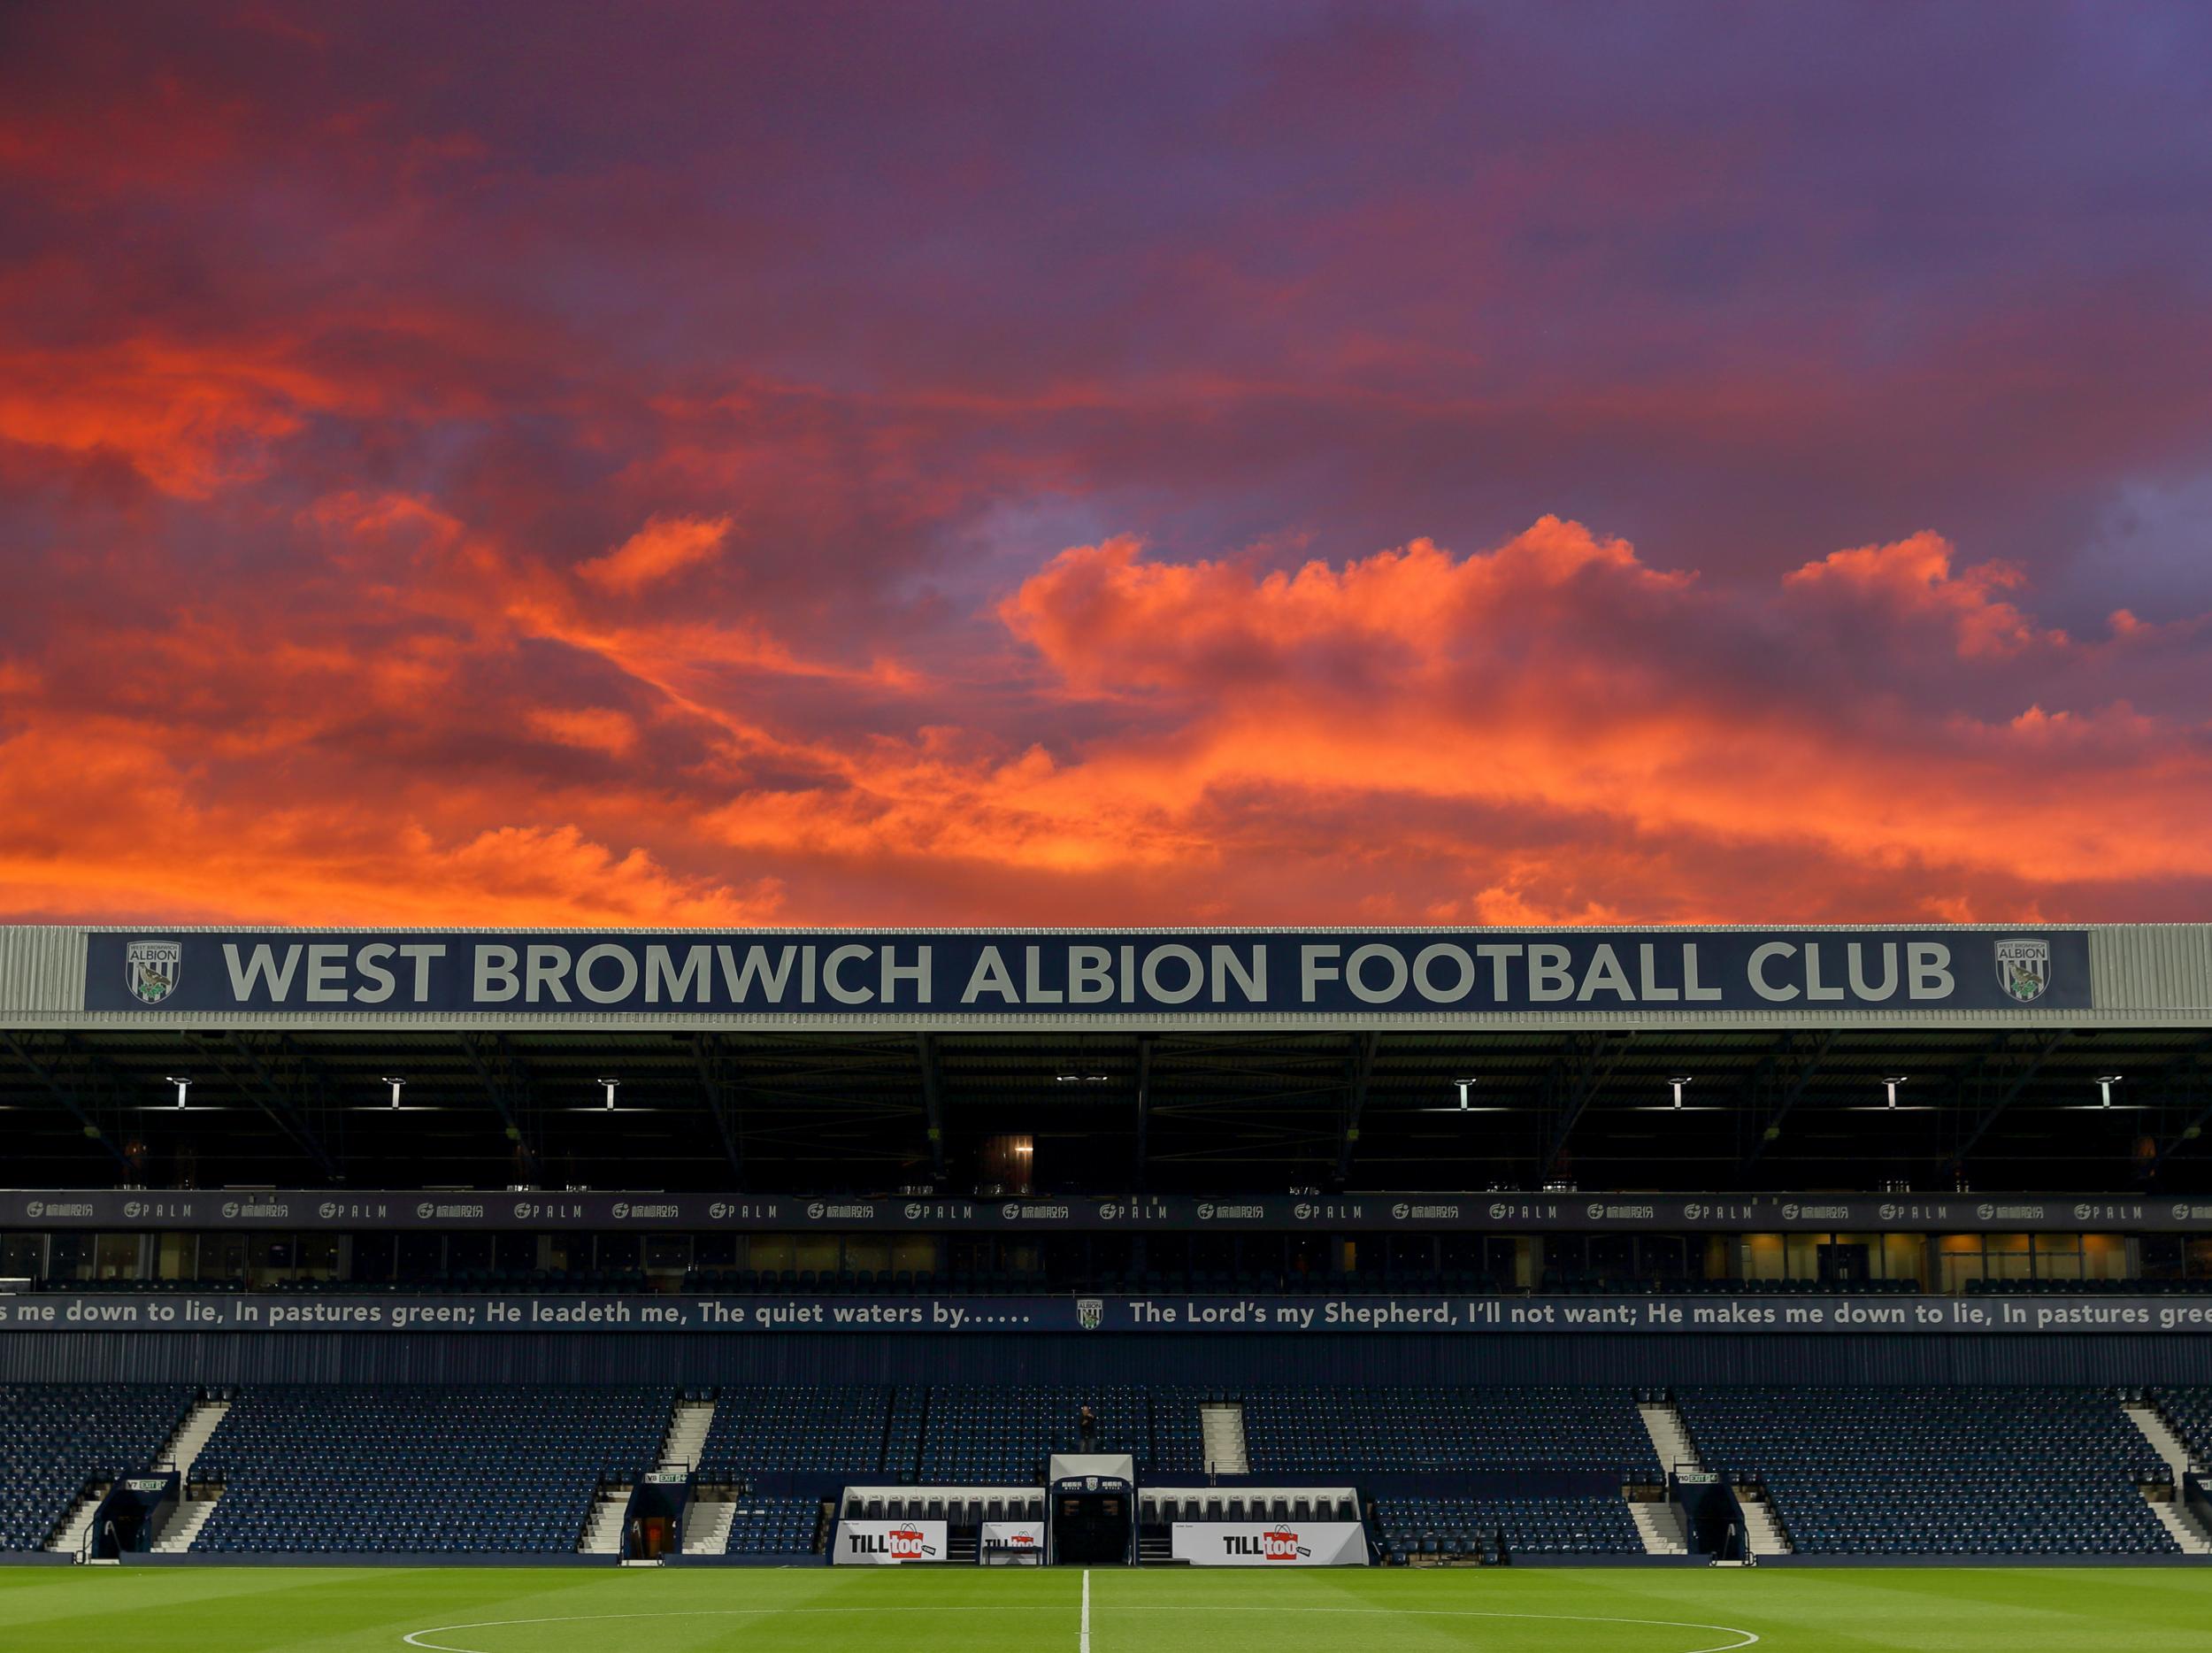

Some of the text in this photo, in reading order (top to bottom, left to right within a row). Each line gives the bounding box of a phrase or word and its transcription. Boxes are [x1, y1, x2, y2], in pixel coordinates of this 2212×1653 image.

[130, 950, 177, 960] ALBION
[1999, 949, 2045, 958] ALBION
[223, 942, 1955, 1003] WEST BROMWICH ALBION FOOTBALL CLUB
[143, 1204, 190, 1217] PALM
[339, 1205, 386, 1217] PALM
[534, 1205, 580, 1218] PALM
[729, 1206, 776, 1218] PALM
[925, 1206, 971, 1218] PALM
[1119, 1206, 1165, 1218] PALM
[1314, 1206, 1361, 1218] PALM
[1509, 1206, 1555, 1218] PALM
[1704, 1207, 1750, 1219] PALM
[1899, 1207, 1946, 1219] PALM
[2093, 1207, 2141, 1219] PALM
[18, 1307, 55, 1320] me
[66, 1301, 136, 1320] down
[148, 1303, 174, 1320] to
[186, 1301, 223, 1324] lie,
[236, 1302, 257, 1320] In
[270, 1303, 380, 1326] pastures
[392, 1308, 474, 1326] green;
[488, 1303, 520, 1321] He
[533, 1302, 629, 1321] leadeth
[642, 1308, 687, 1325] me,
[699, 1302, 744, 1322] The
[757, 1303, 823, 1327] quiet
[833, 1305, 922, 1322] waters
[1130, 1302, 1176, 1322] The
[1188, 1302, 1265, 1322] Lord’s
[1278, 1309, 1314, 1328] my
[1325, 1302, 1456, 1328] Shepherd,
[1470, 1303, 1500, 1322] I’ll
[1512, 1305, 1554, 1322] not
[1564, 1305, 1636, 1325] want;
[1649, 1303, 1682, 1322] He
[1694, 1303, 1775, 1322] makes
[1786, 1309, 1823, 1322] me
[1835, 1303, 1905, 1323] down
[1916, 1305, 1942, 1323] to
[1954, 1303, 1992, 1326] lie,
[2004, 1303, 2026, 1322] In
[2038, 1305, 2149, 1328] pastures
